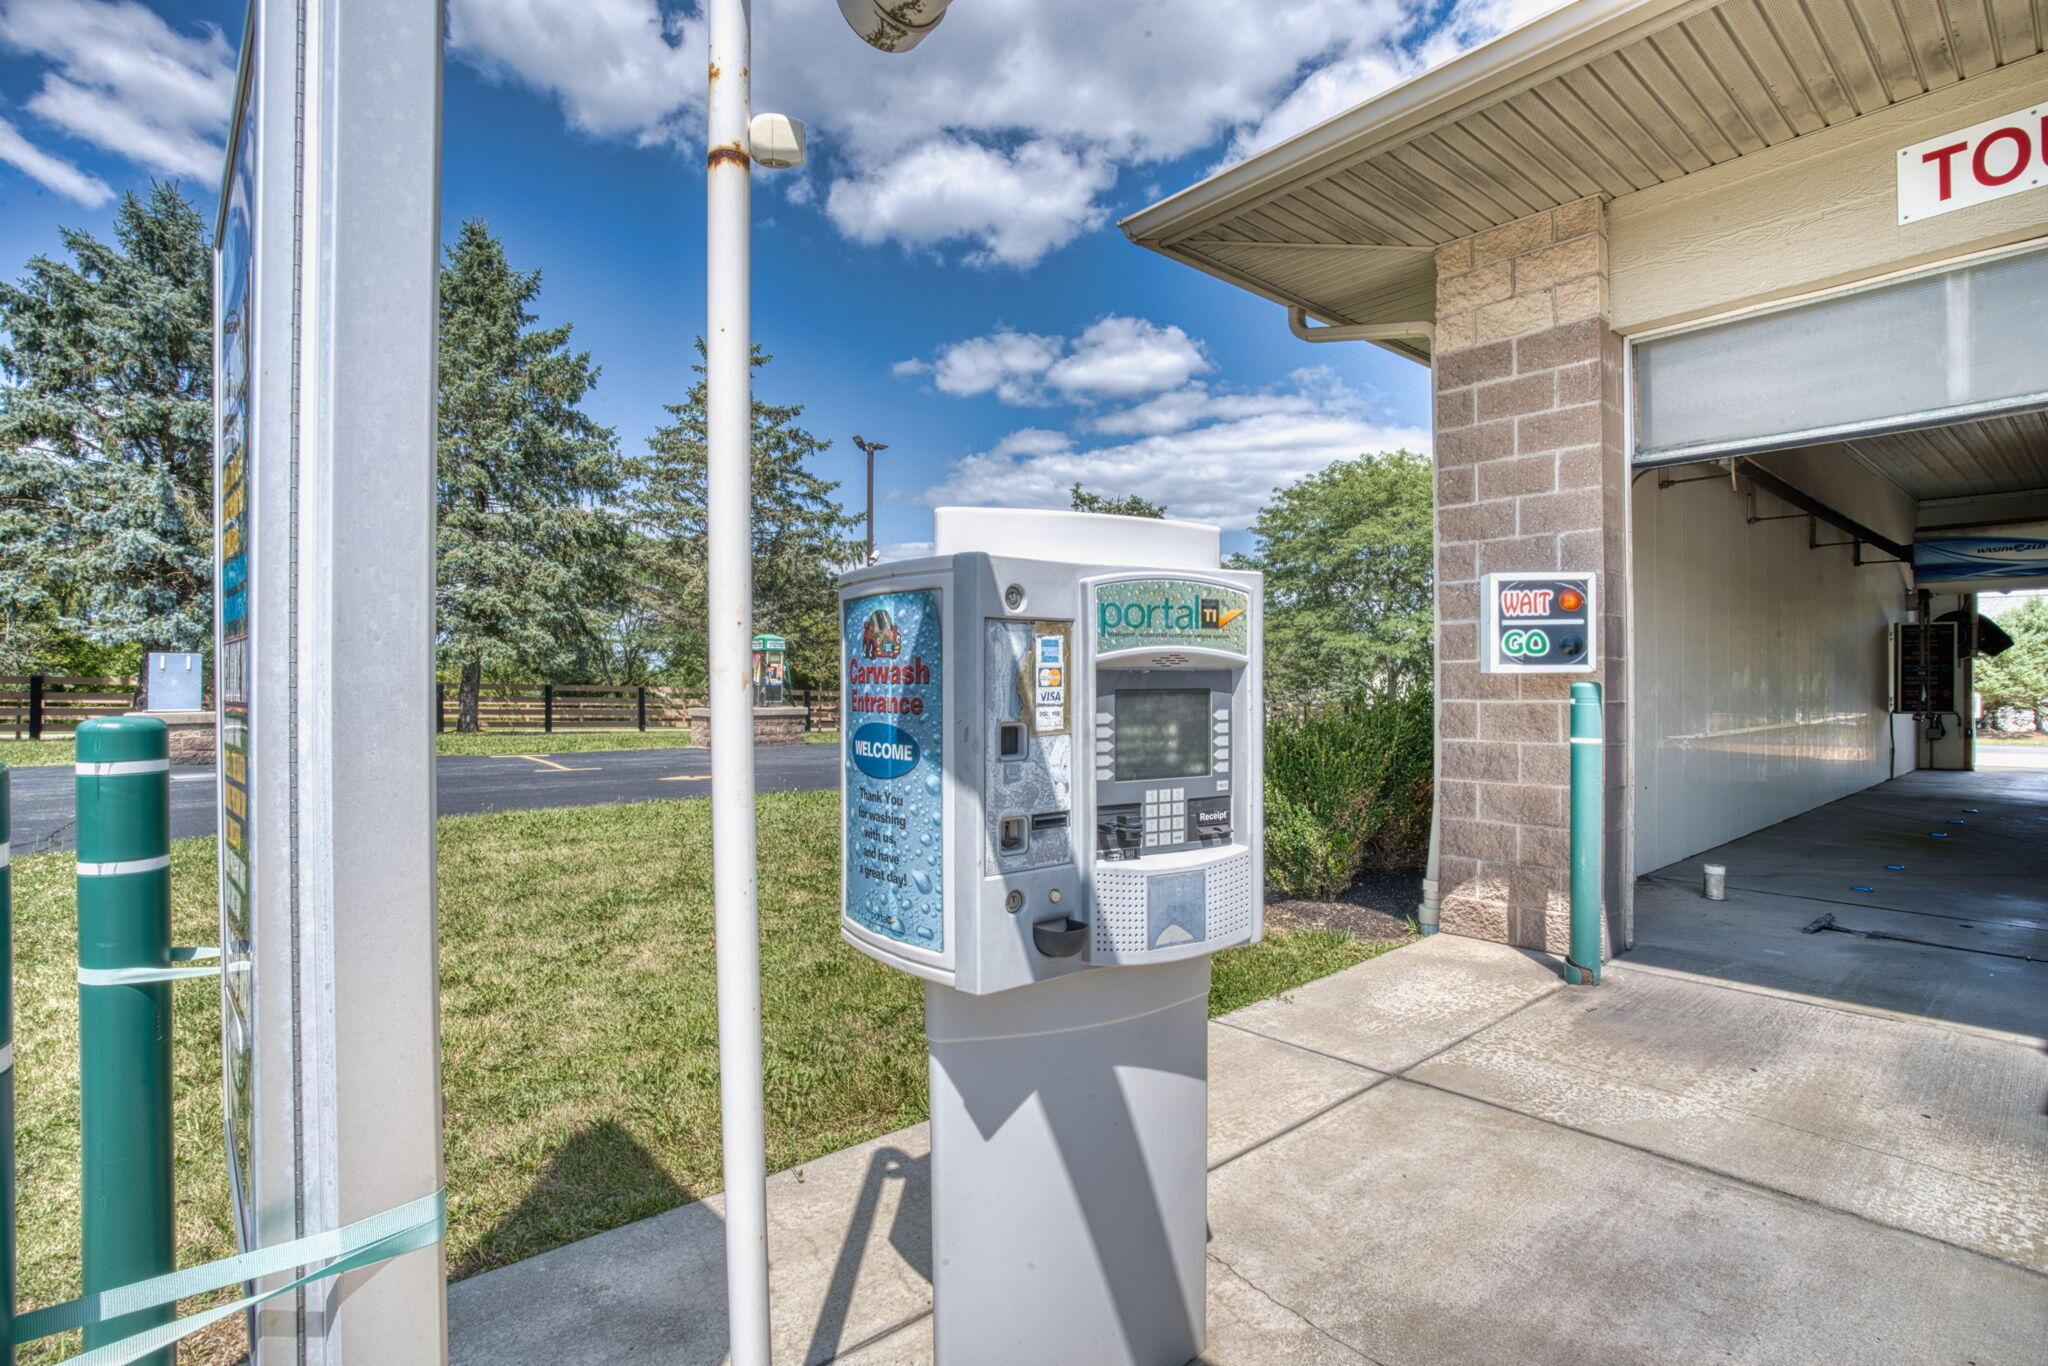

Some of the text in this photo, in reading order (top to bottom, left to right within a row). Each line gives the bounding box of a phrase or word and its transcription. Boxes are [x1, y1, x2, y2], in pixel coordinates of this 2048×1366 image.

[1921, 114, 2048, 201] TO
[1502, 590, 1553, 615] WAIT
[1100, 594, 1199, 637] portal
[1502, 630, 1550, 656] GO
[849, 656, 930, 685] Carwash
[850, 689, 924, 715] Entrance
[1040, 691, 1061, 701] VISA
[855, 740, 913, 761] WELCOME
[859, 787, 903, 806] Thank You
[858, 805, 906, 830] for washing
[1200, 811, 1227, 821] Receipt
[864, 828, 896, 846] with us,
[863, 847, 900, 865] and have
[859, 865, 908, 888] a great day!
